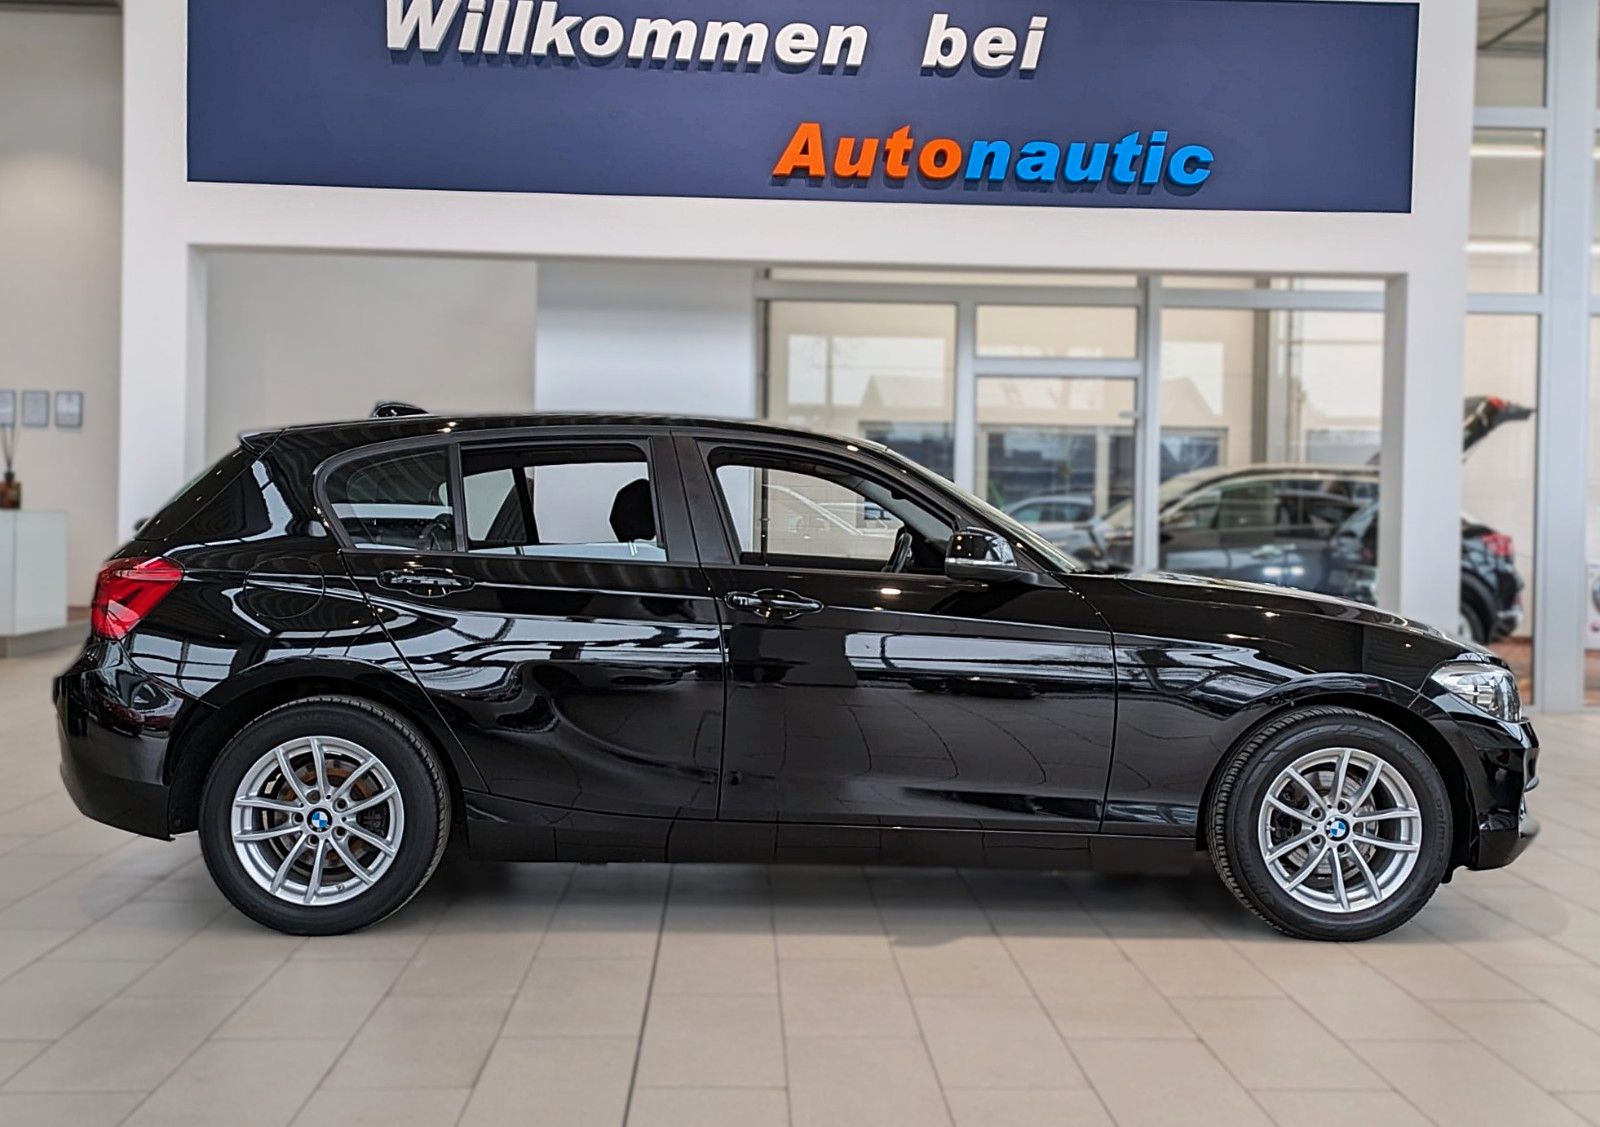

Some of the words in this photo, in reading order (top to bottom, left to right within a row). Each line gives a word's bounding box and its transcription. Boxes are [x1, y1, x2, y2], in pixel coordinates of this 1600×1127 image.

[386, 0, 868, 67] Willkommen
[921, 13, 1048, 70] bei
[772, 121, 1215, 186] Autonautic
